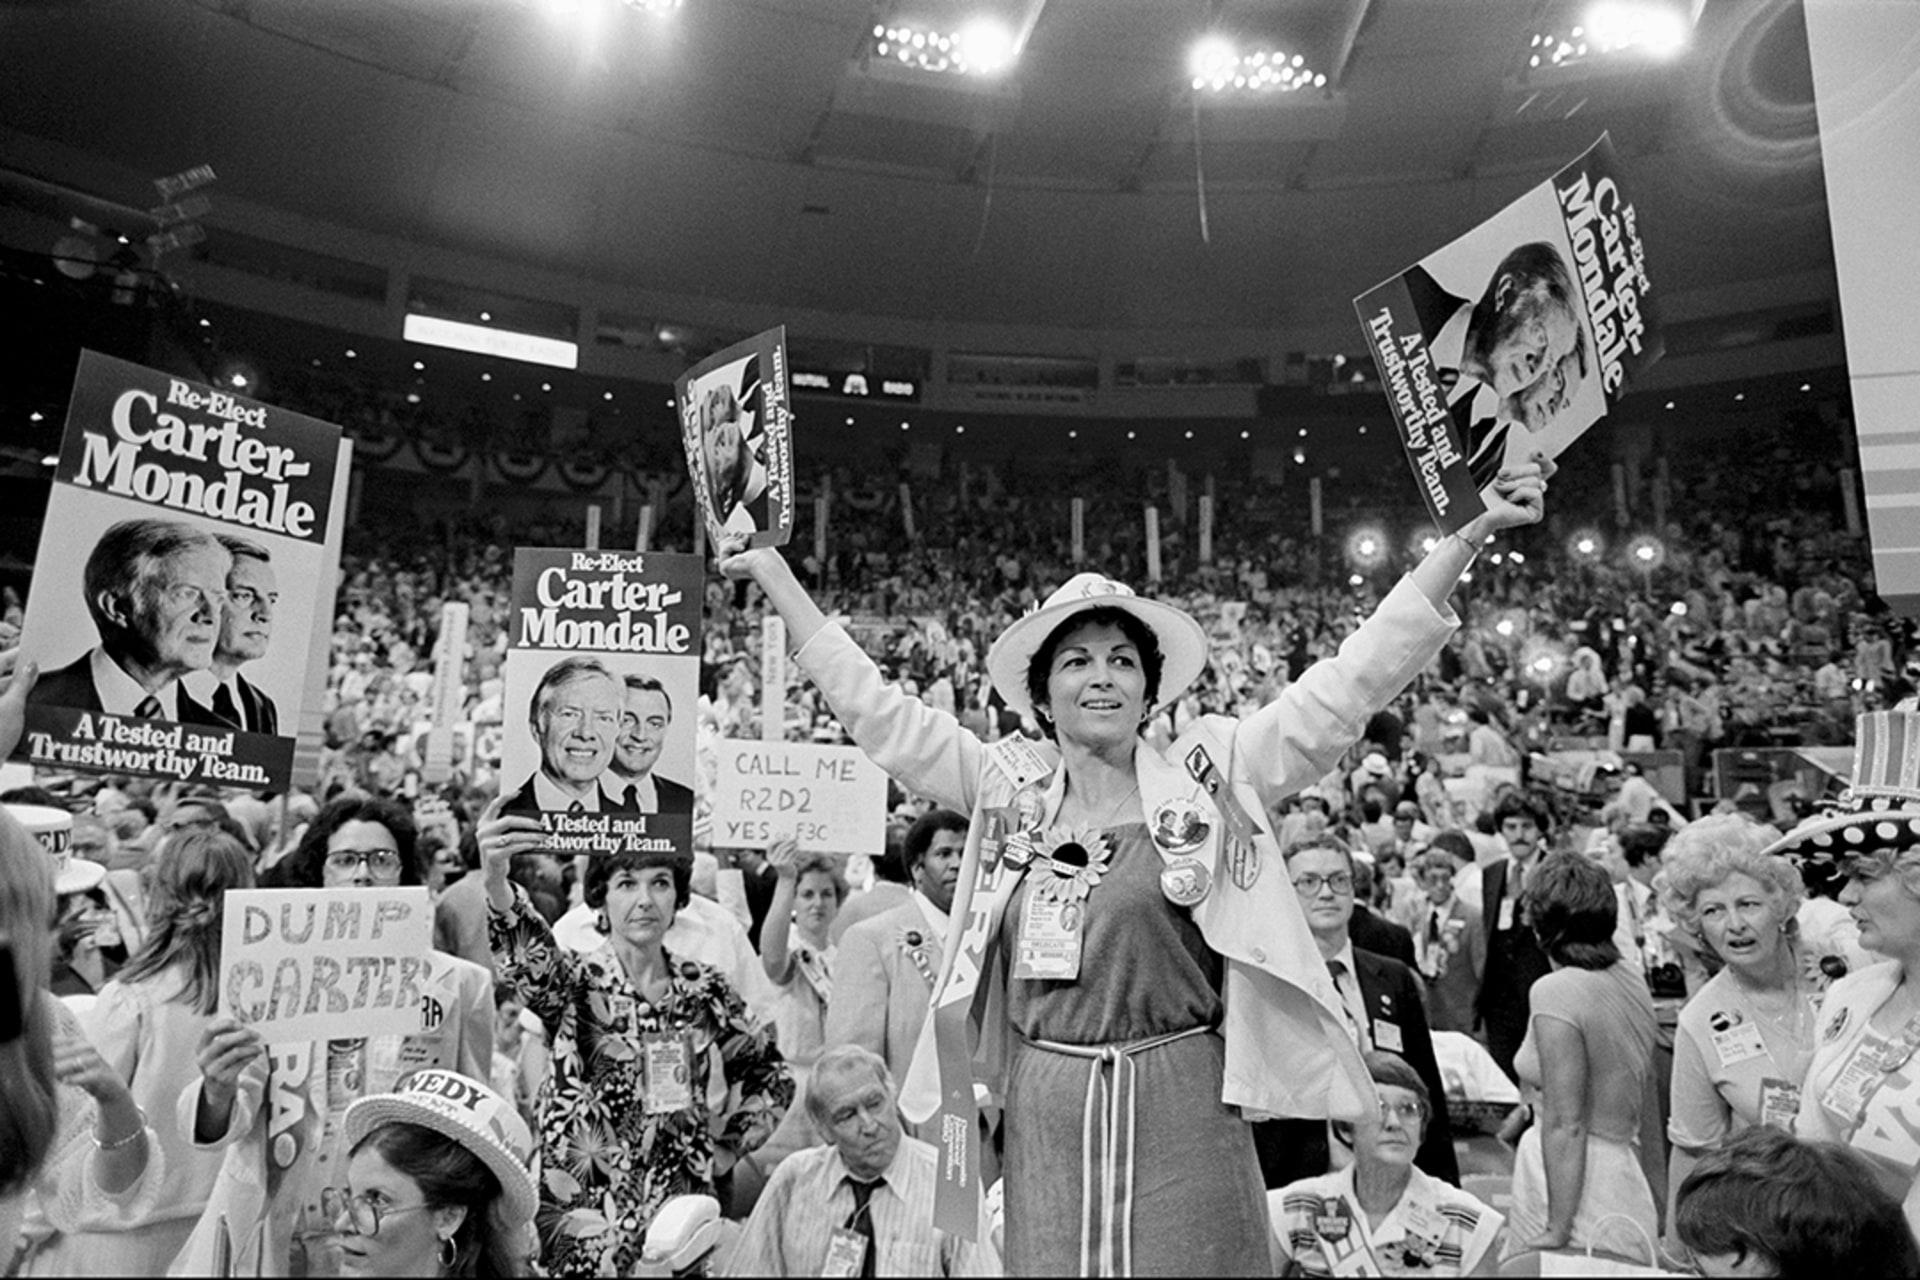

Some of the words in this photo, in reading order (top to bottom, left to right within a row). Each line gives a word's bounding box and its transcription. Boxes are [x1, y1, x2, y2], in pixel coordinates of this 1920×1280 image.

[1594, 176, 1644, 356] Carter-
[1621, 203, 1650, 296] Re-Elect
[1558, 171, 1624, 394] Mondale
[1399, 332, 1423, 356] A
[772, 344, 785, 408] Team.
[1407, 347, 1448, 425] Tested
[167, 379, 267, 429] Re-Elect
[760, 381, 776, 420] and
[1369, 307, 1428, 449] Trustworthy
[1416, 444, 1450, 516] Team.
[112, 388, 311, 483] Carter-
[763, 420, 780, 486] Tested
[1430, 424, 1462, 470] and
[73, 430, 315, 538] Mondale
[775, 406, 790, 529] Trustworthy
[767, 485, 781, 502] A
[571, 552, 644, 573] Re-Elect
[536, 566, 682, 612] Carter-
[517, 607, 690, 653] Mondale
[72, 712, 96, 740] A
[98, 715, 183, 750] Tested
[185, 732, 235, 756] and
[28, 732, 198, 780] Trustworthy
[199, 752, 271, 784] Team.
[735, 752, 800, 775] CALL
[815, 757, 856, 782] ME
[540, 813, 553, 831] A
[553, 814, 610, 833] Tested
[612, 816, 647, 833] and
[740, 787, 812, 813] R2D2
[541, 833, 622, 855] stworthy
[624, 834, 677, 852] Team.
[727, 821, 770, 841] YES
[242, 902, 412, 945] DUMP
[226, 956, 430, 1024] CARTER
